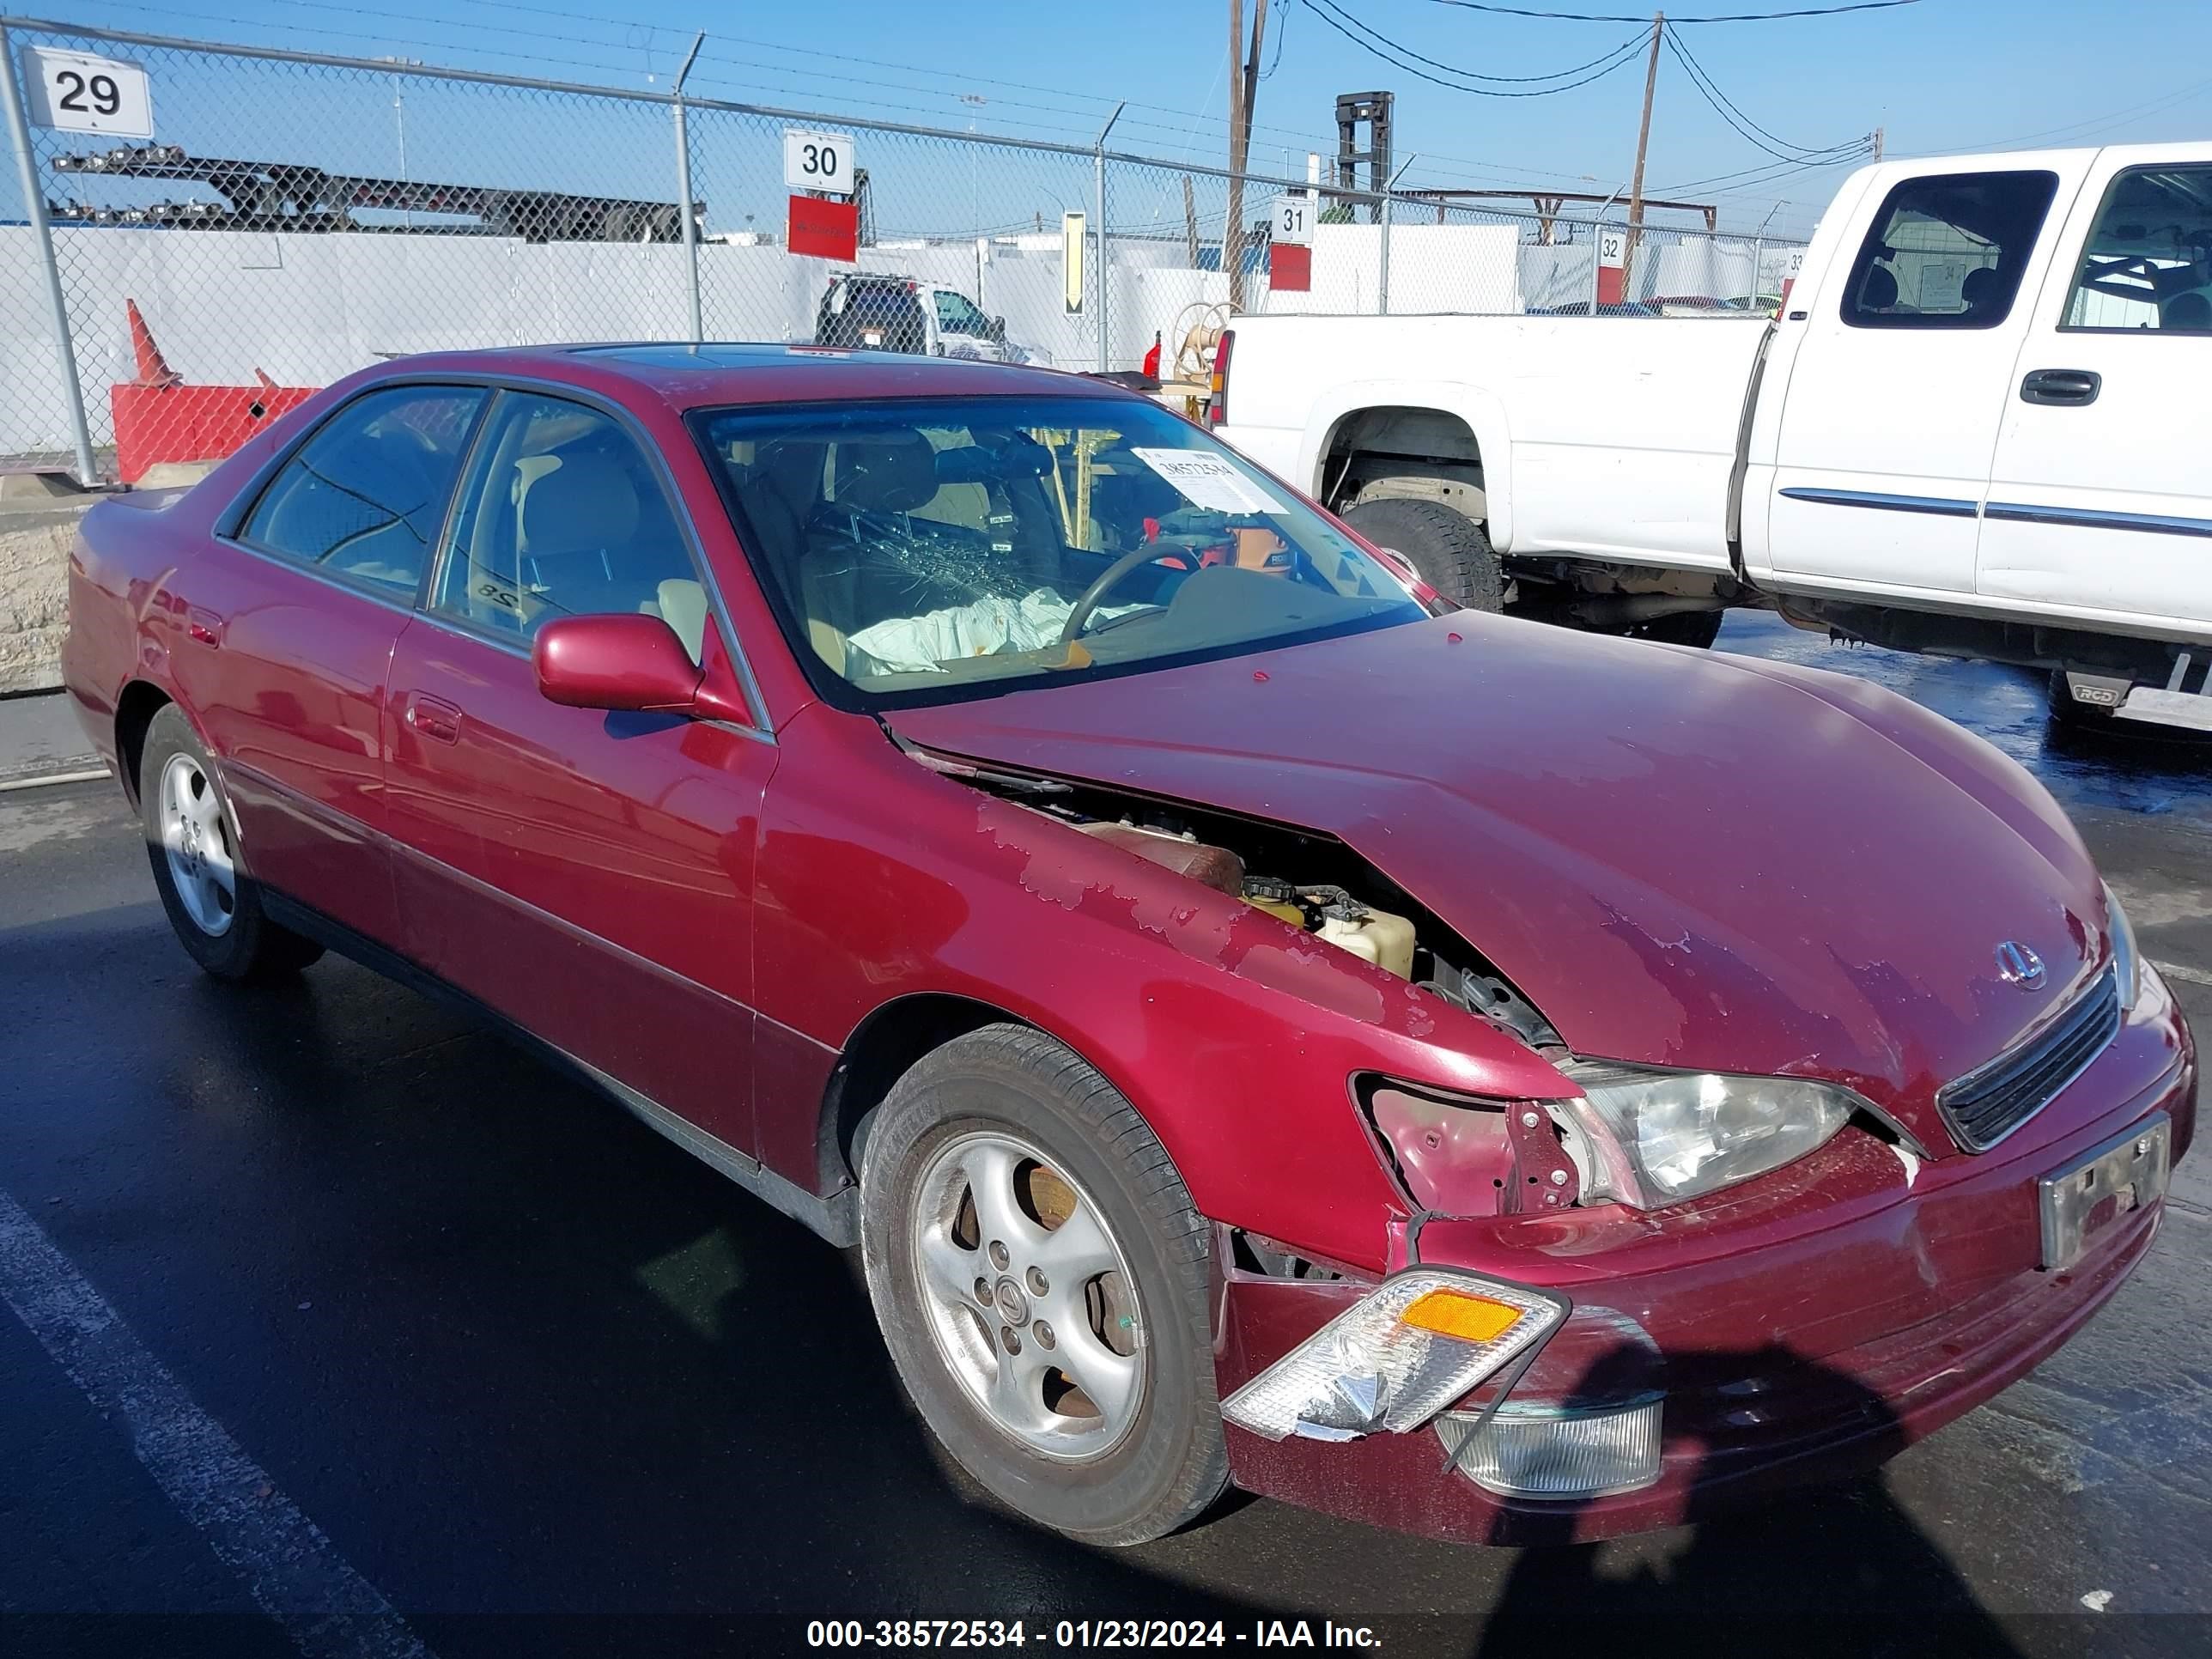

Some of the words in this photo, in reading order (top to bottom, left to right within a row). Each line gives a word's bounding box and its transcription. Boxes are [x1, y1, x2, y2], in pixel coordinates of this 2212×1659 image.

[56, 70, 121, 117] 29
[802, 144, 837, 177] 30
[1283, 209, 1303, 233] 31
[1602, 239, 1618, 258] 32
[1790, 254, 1803, 271] 33
[1159, 462, 1236, 477] 38572534
[2080, 689, 2112, 702] RCD
